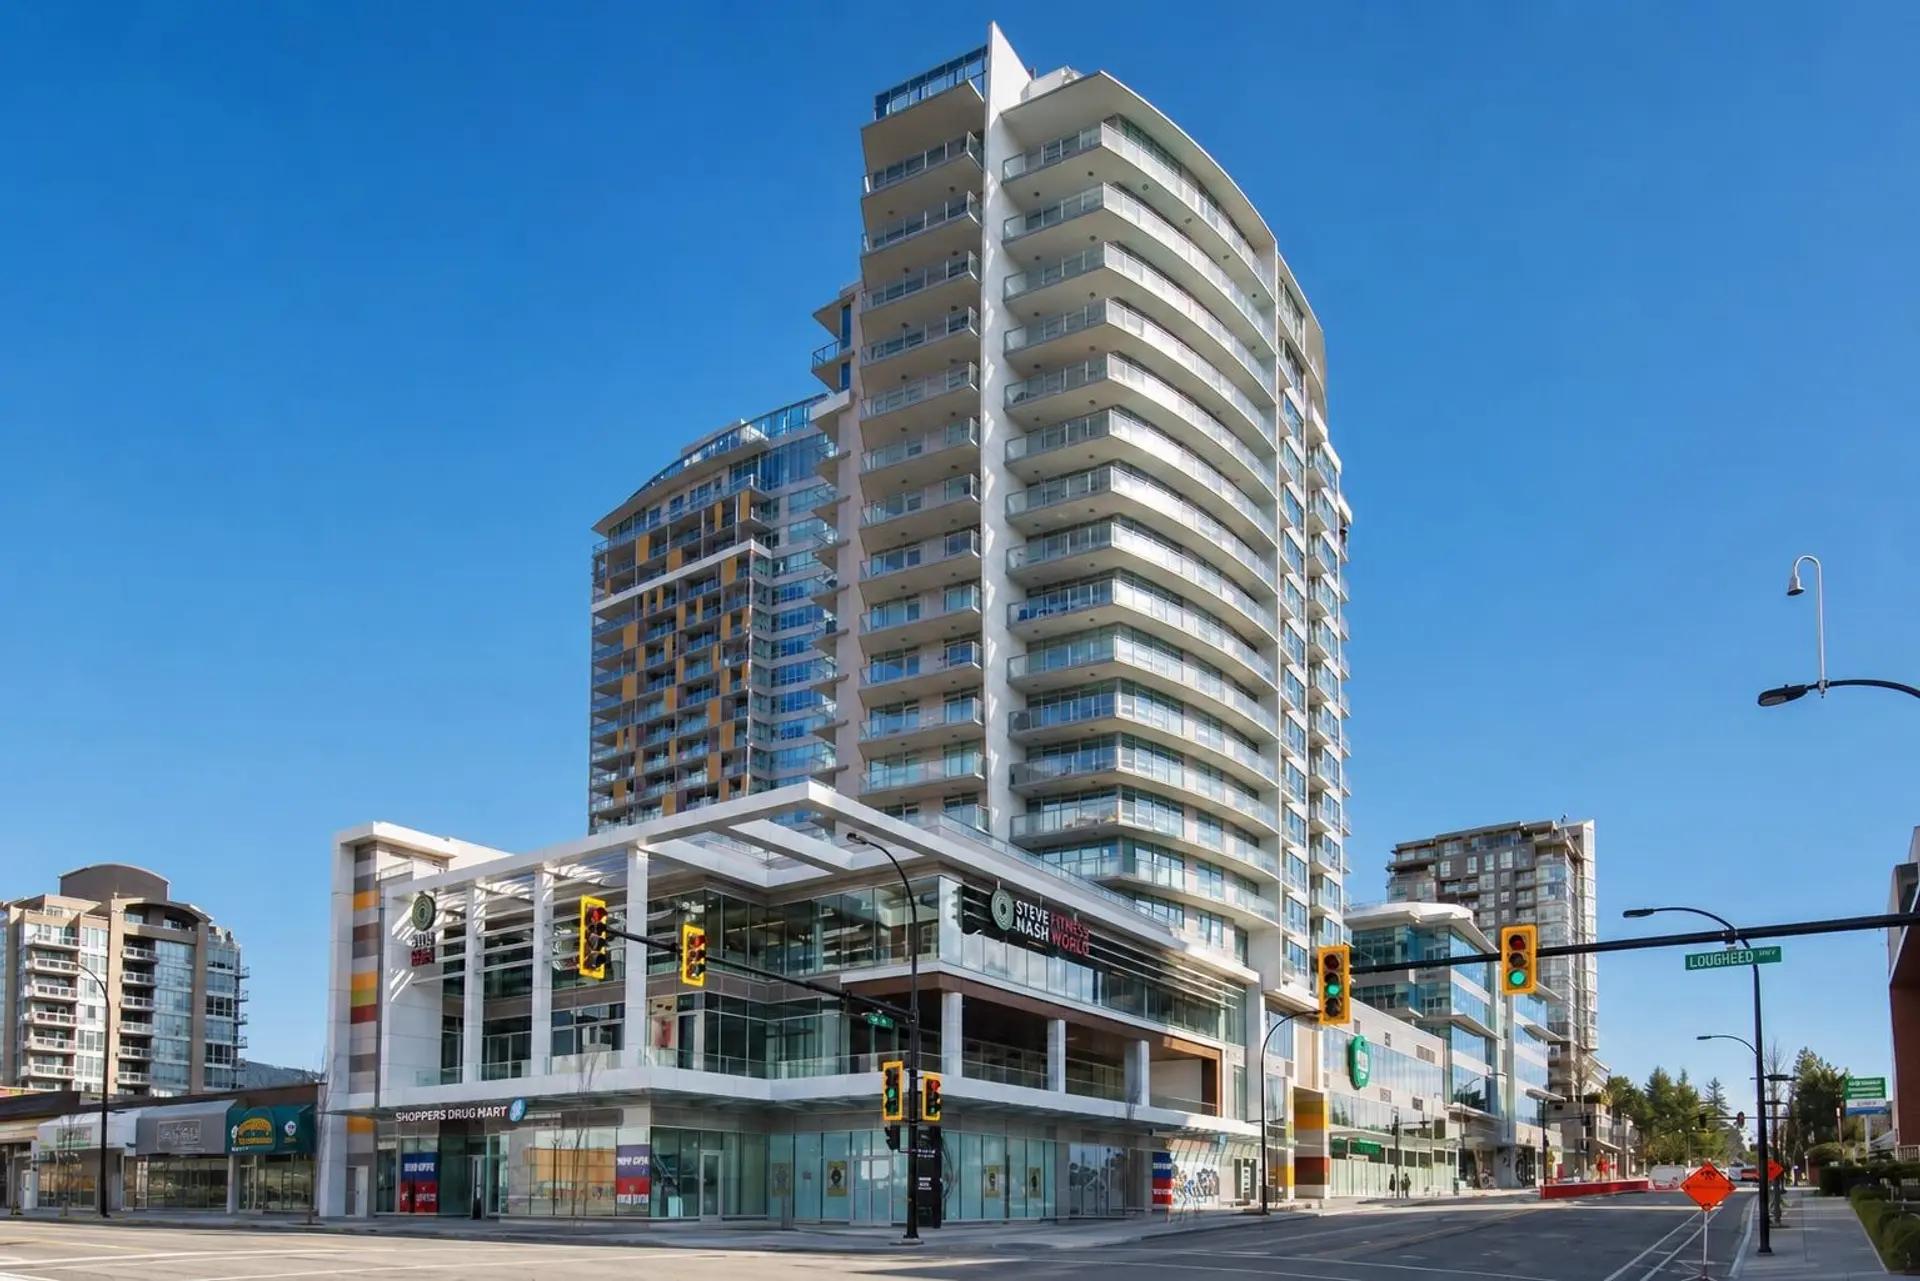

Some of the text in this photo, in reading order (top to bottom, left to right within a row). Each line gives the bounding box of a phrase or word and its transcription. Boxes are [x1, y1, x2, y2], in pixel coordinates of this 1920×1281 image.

[1016, 900, 1050, 925] STEVE
[1051, 911, 1090, 939] FITNESS
[1016, 916, 1050, 942] NASH
[1051, 931, 1090, 956] WORLD
[1689, 950, 1754, 968] LOUGHEED
[395, 1105, 507, 1122] SHOPPERS DRUG MART
